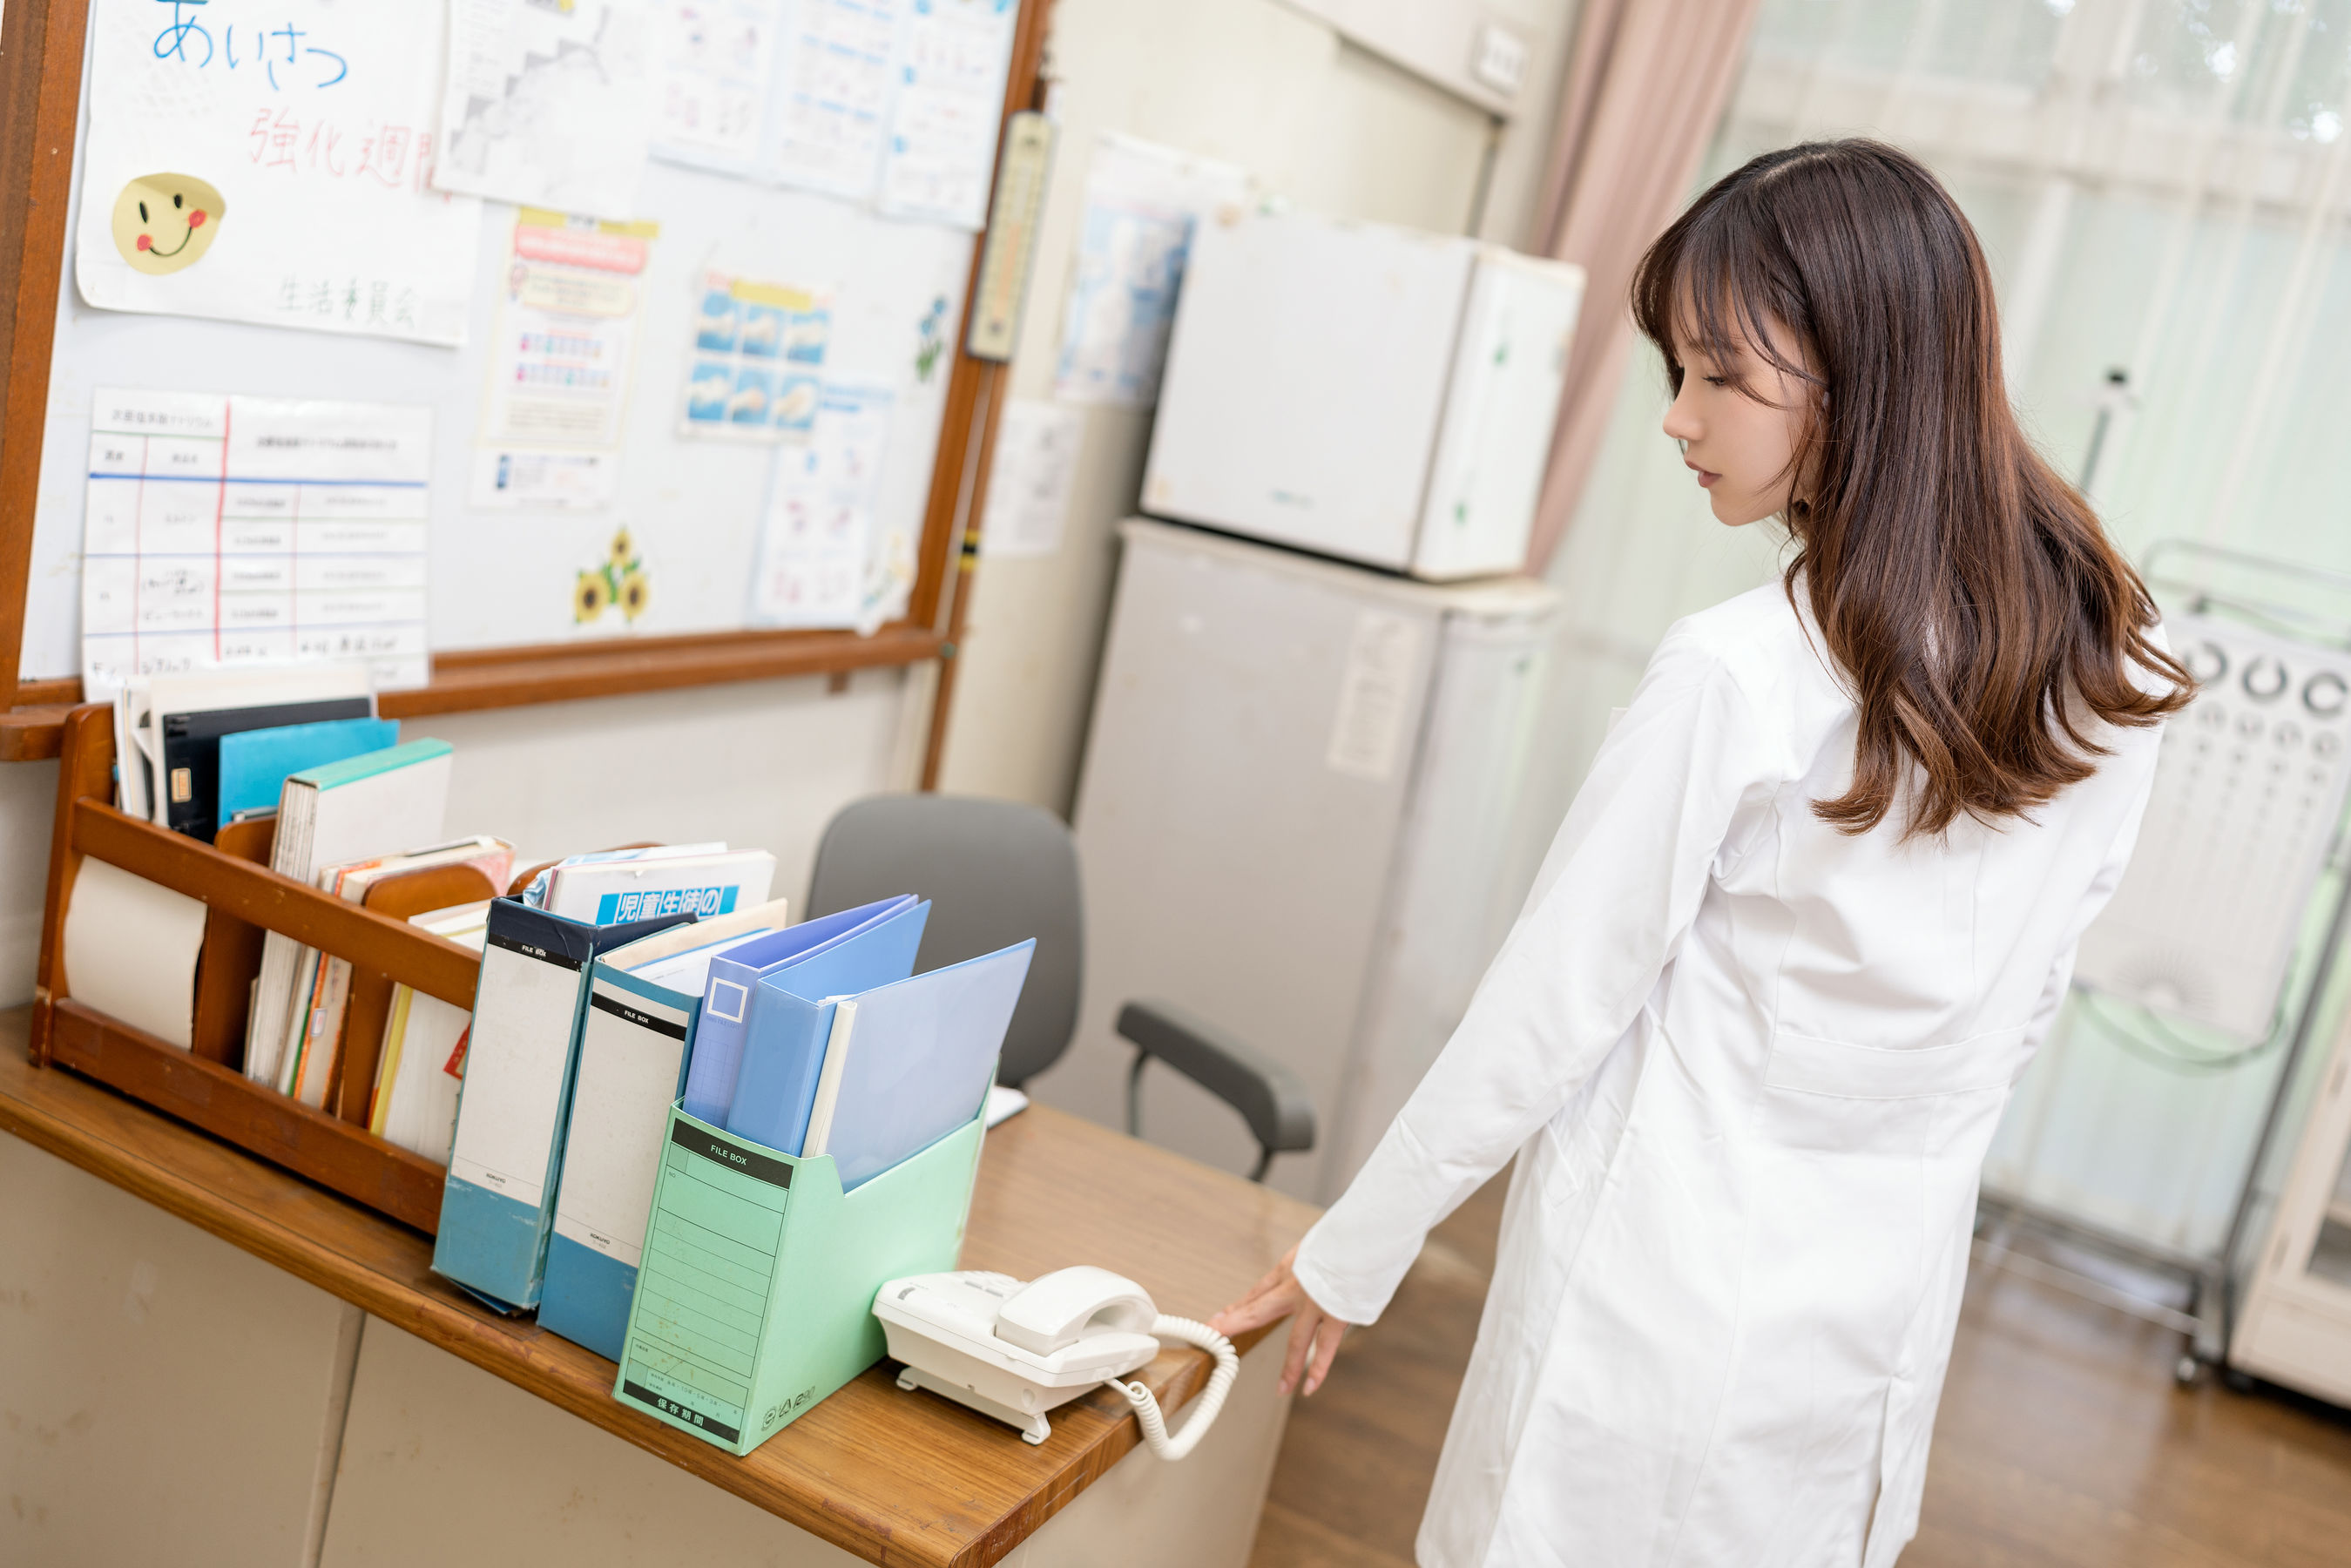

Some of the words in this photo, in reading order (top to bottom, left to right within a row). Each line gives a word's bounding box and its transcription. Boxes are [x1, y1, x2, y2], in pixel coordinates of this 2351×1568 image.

[154, 0, 347, 90] あいさつ
[277, 275, 418, 328] 生活委員会
[618, 889, 719, 922] 児童生徒の
[522, 944, 534, 954] FILE
[536, 947, 547, 957] BOX
[624, 1010, 636, 1019] FILE
[638, 1015, 649, 1024] BOX
[710, 1144, 728, 1159] FILE
[730, 1152, 747, 1166] BOX
[657, 1397, 705, 1427] 保存期間
